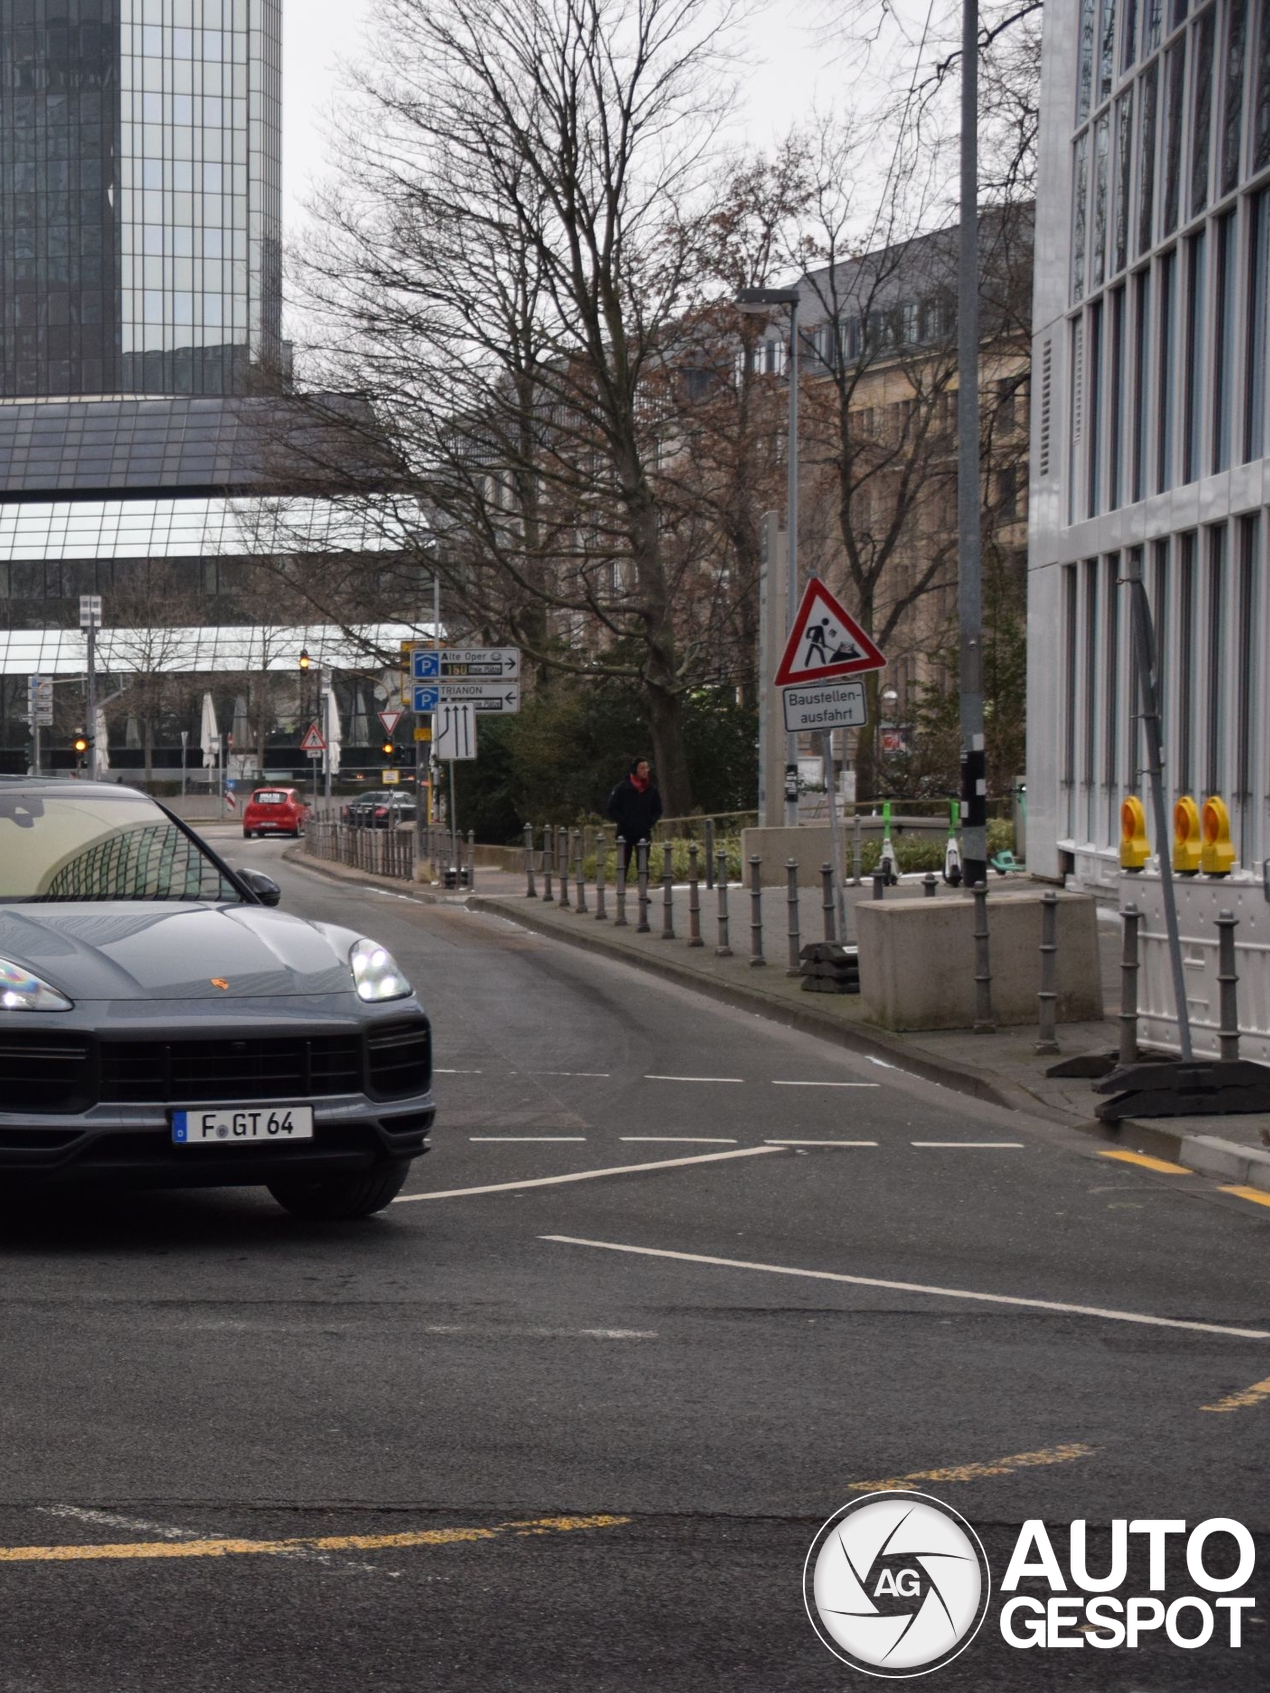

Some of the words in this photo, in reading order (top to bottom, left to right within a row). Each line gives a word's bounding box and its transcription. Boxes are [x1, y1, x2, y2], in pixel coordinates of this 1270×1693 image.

[441, 652, 461, 661] Alte
[465, 652, 487, 663] Oper
[421, 660, 432, 673] P
[441, 686, 483, 695] TRIANON
[421, 694, 432, 708] P
[788, 690, 861, 706] Baustellen-
[801, 708, 853, 724] ausfahrt
[202, 1114, 217, 1138] F
[232, 1112, 261, 1137] GT
[267, 1111, 294, 1136] 64
